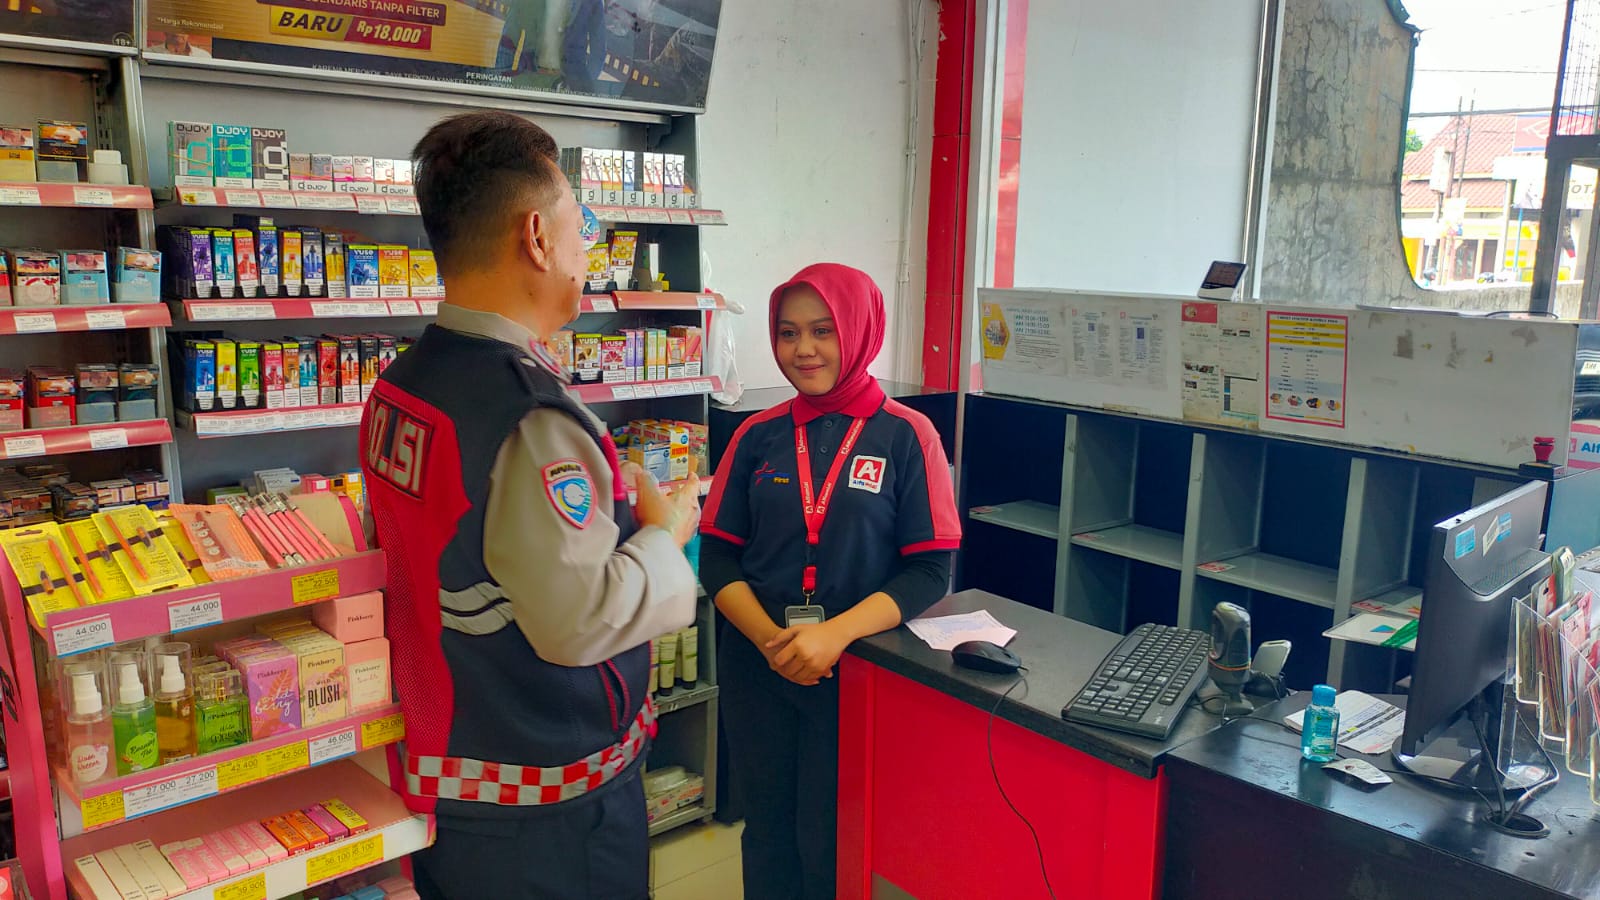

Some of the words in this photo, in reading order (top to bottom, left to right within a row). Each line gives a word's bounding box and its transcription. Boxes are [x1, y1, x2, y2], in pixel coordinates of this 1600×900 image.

[371, 1, 404, 14] TANPA
[406, 6, 440, 18] FILTER
[278, 11, 343, 32] BARU
[466, 71, 512, 83] PERINGATAN
[176, 123, 209, 132] DJOY
[216, 126, 248, 135] DJOY
[252, 128, 283, 138] DJOY
[190, 601, 219, 612] 44.000
[76, 622, 107, 636] 44.000
[308, 684, 340, 708] BLUSH
[327, 732, 353, 744] 46.000
[282, 747, 307, 760] 42.500
[186, 770, 215, 784] 27.200
[146, 780, 176, 794] 27.000
